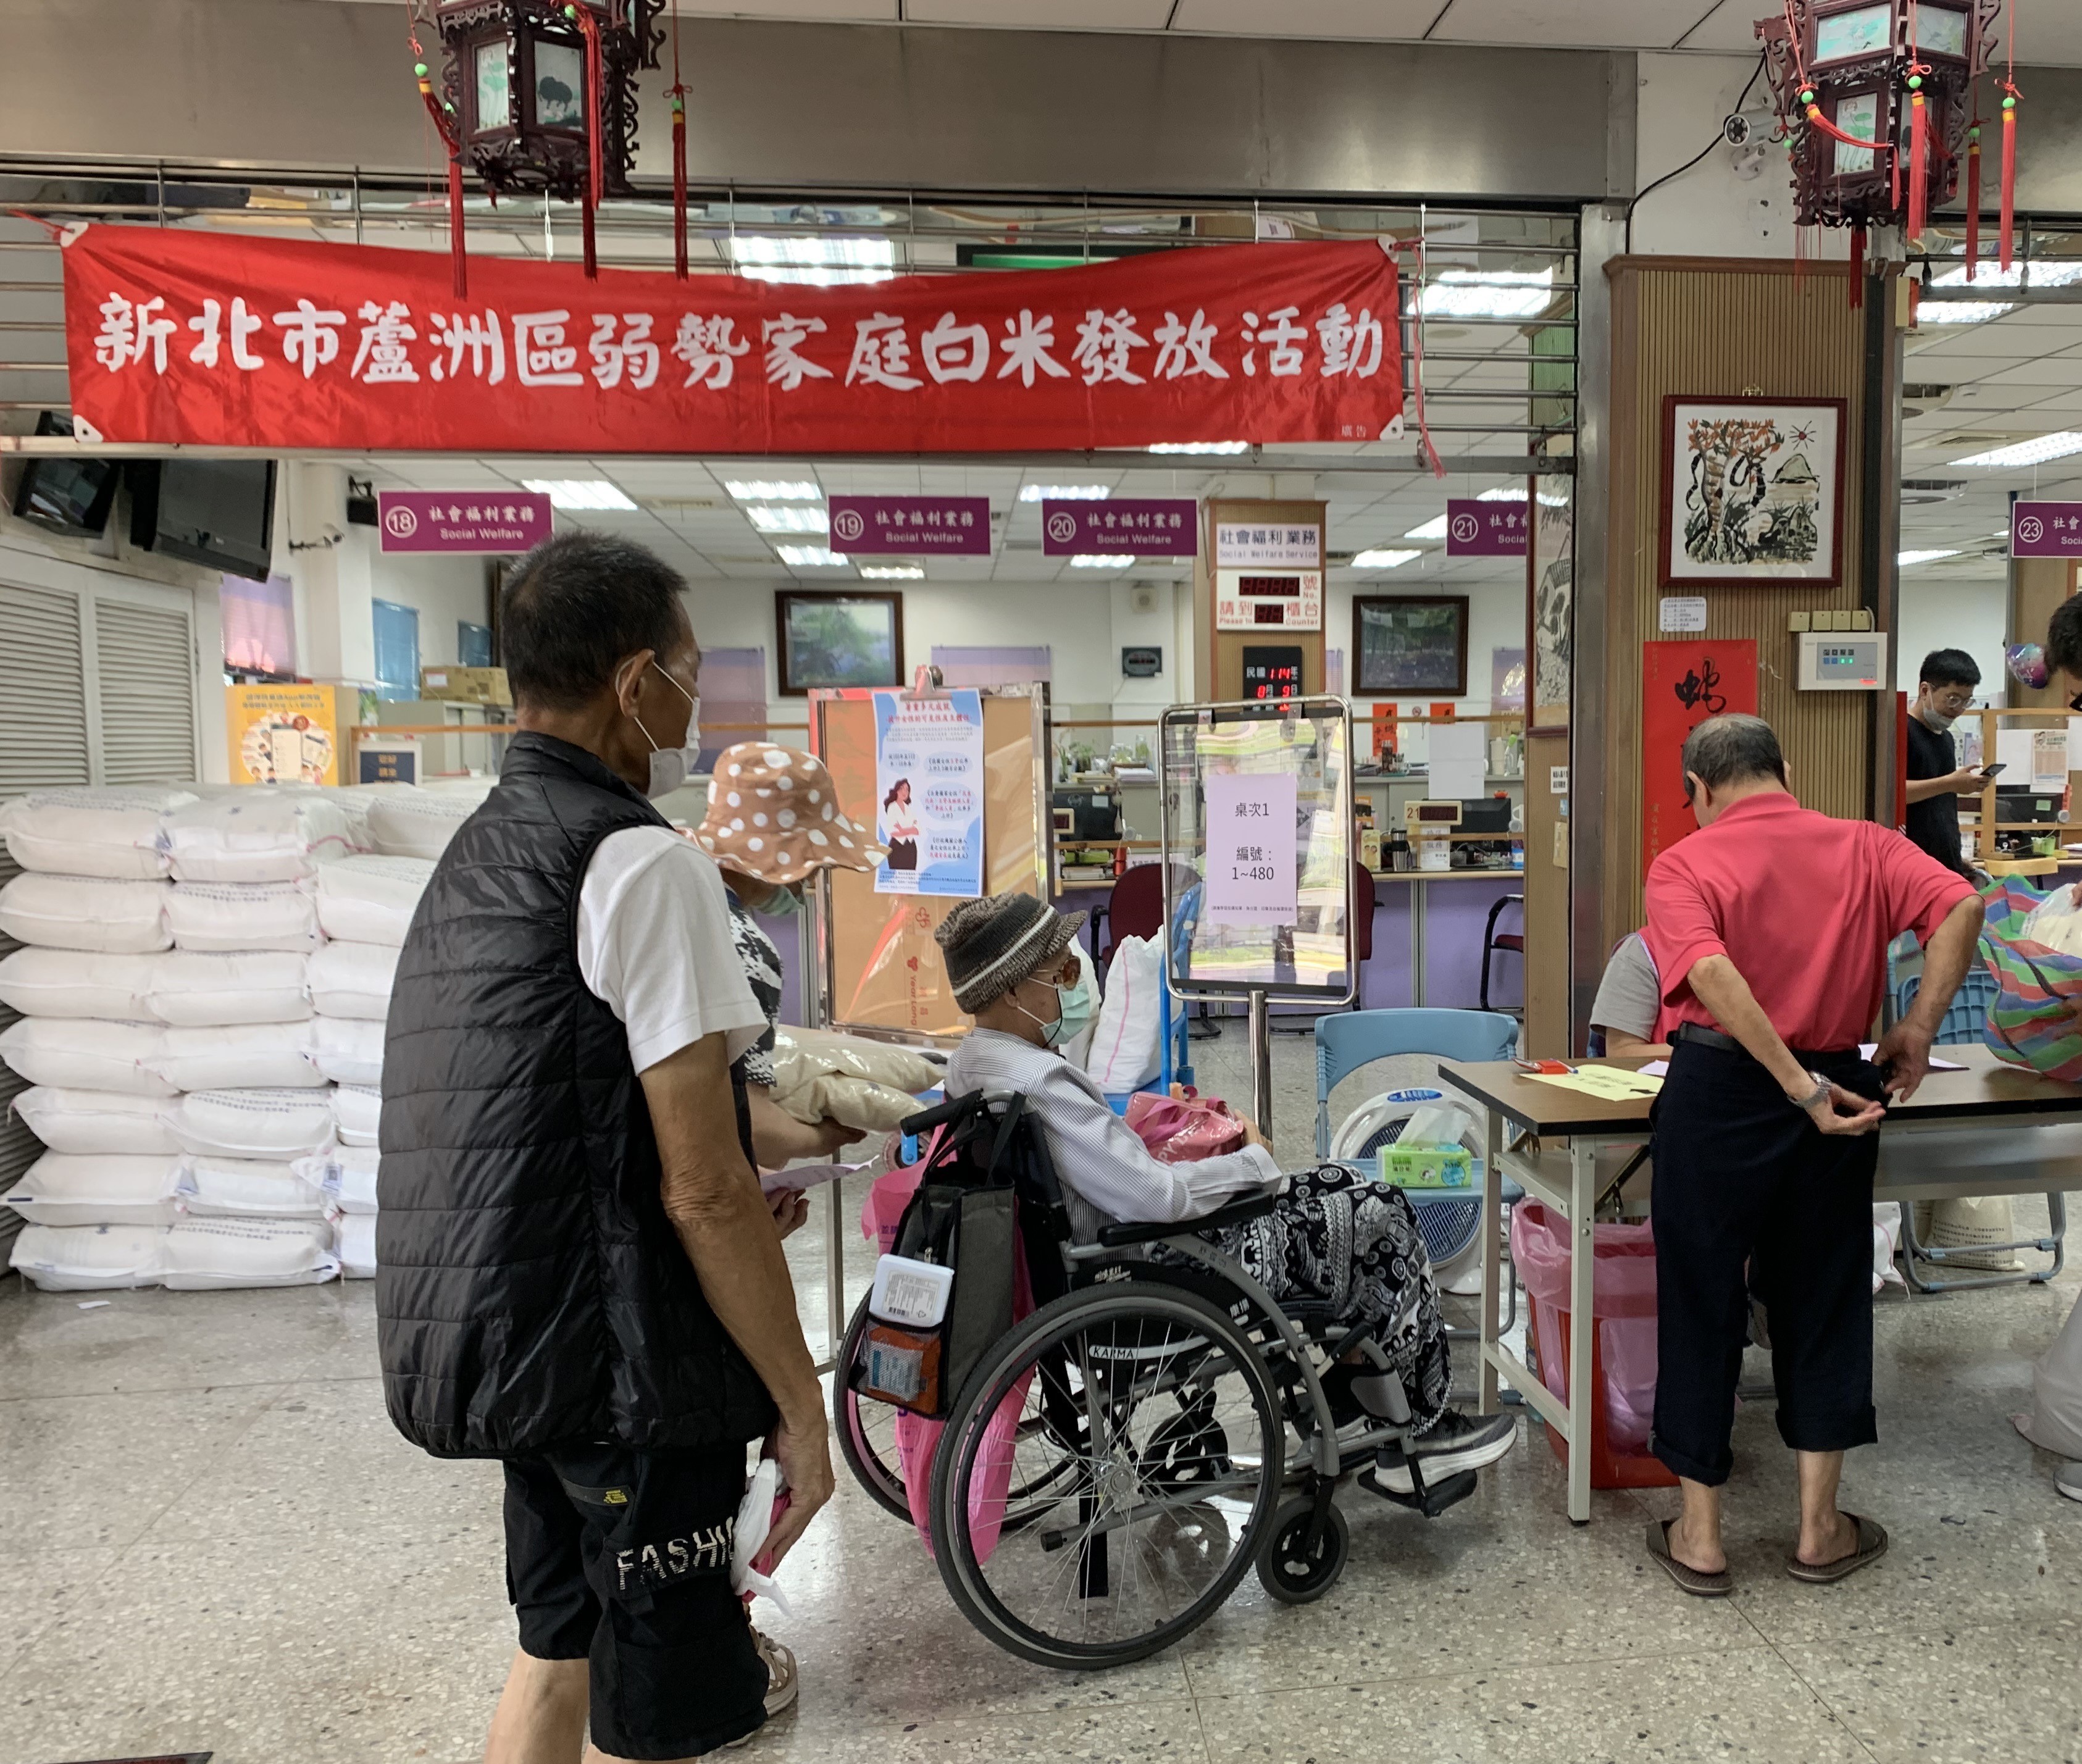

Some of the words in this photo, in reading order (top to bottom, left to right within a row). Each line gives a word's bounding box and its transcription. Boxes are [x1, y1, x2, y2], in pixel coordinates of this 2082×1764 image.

[94, 290, 1384, 391] 新北市蘆洲區弱勢家庭白米發放活動
[428, 504, 535, 524] 社會福利業務
[874, 509, 976, 527] 社會福利業務
[1087, 512, 1184, 529] 社會福利業務
[440, 528, 476, 540] Social
[479, 528, 524, 540] Welfare
[885, 532, 919, 543] Social
[922, 532, 964, 544] Welfare
[1096, 534, 1130, 545] Social
[1132, 534, 1172, 545] Welfare
[1219, 529, 1316, 545] 社會福利業務
[2060, 536, 2082, 545] Soci
[1219, 550, 1246, 558] Social
[1251, 550, 1283, 559] Welfare
[1286, 550, 1318, 559] Service
[1235, 802, 1269, 817] 桌次1
[1232, 866, 1274, 880] 1~480
[1093, 1346, 1134, 1359] KARMA
